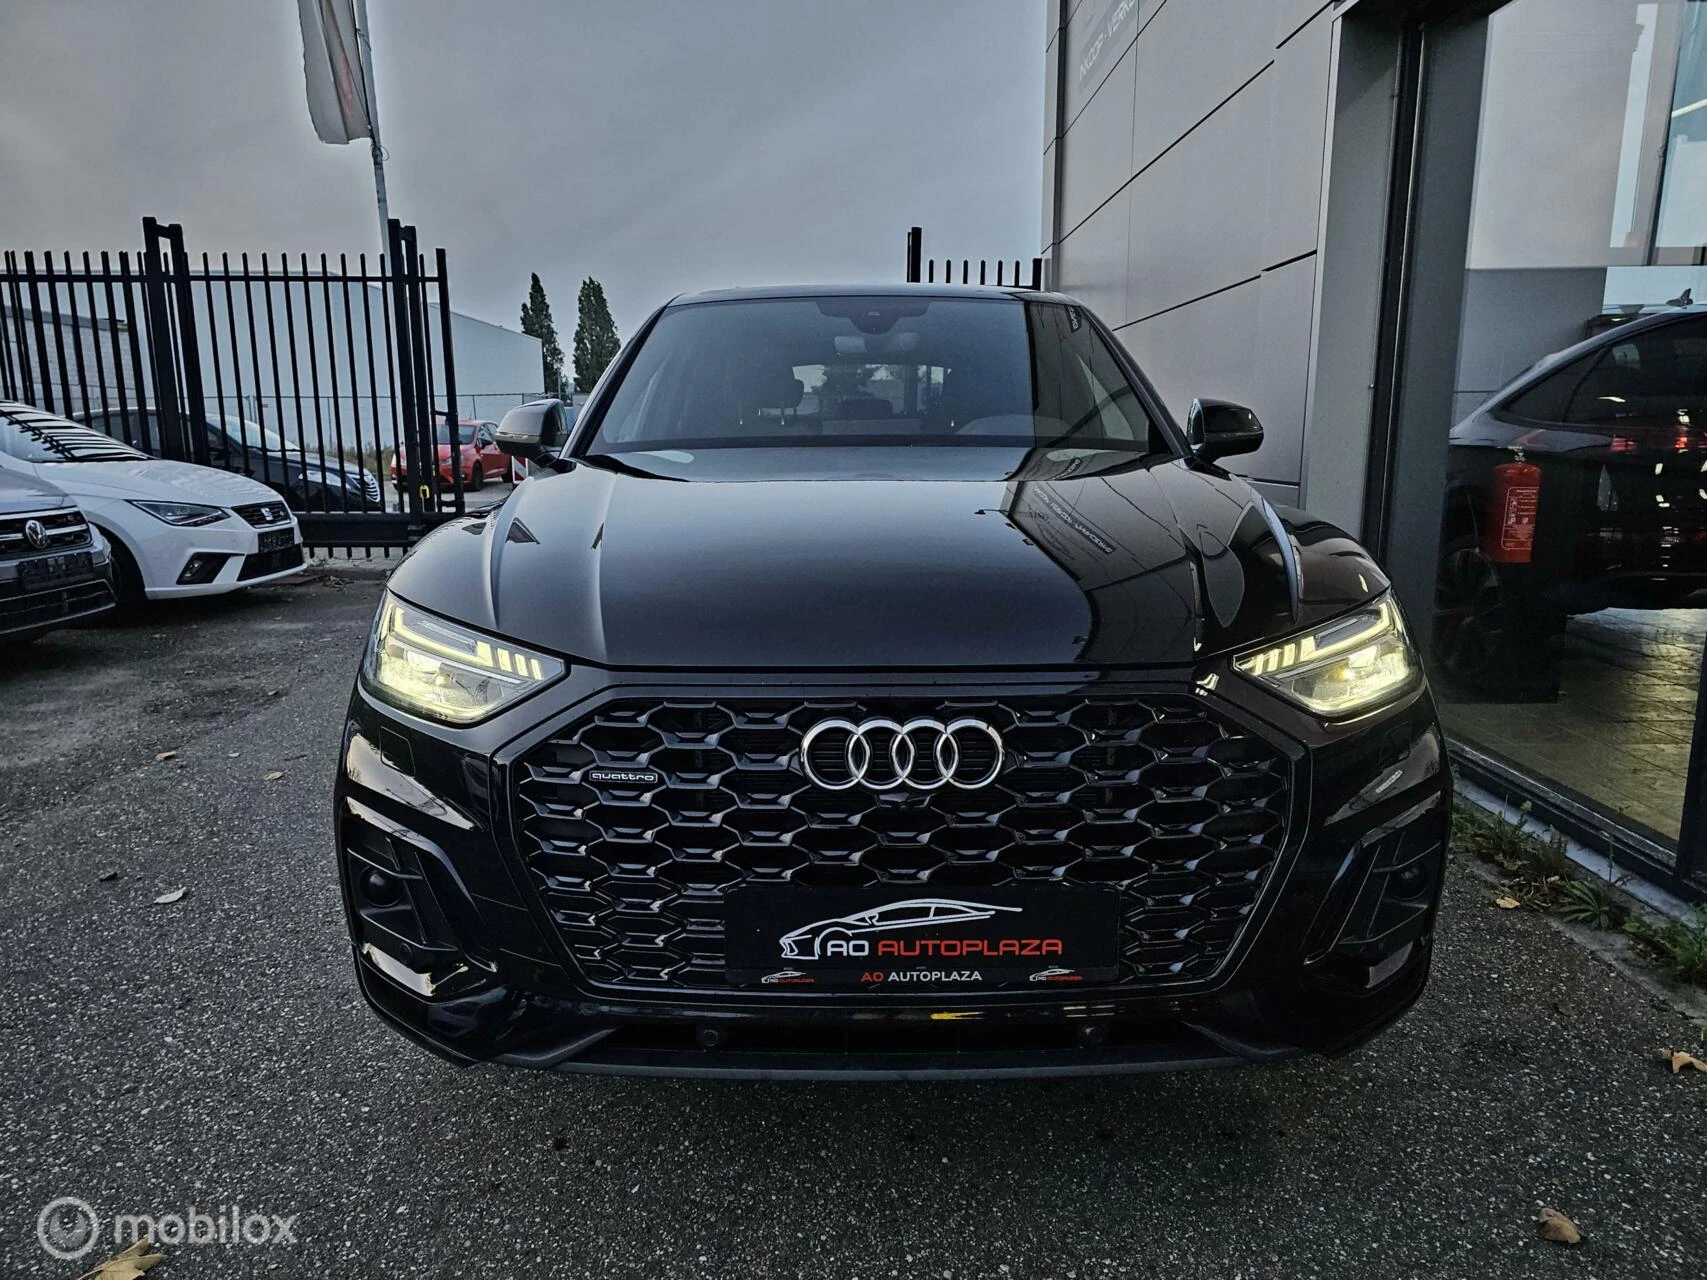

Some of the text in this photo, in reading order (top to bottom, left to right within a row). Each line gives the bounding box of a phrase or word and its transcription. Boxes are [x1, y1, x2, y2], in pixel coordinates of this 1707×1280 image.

[592, 773, 654, 781] quattro
[826, 939, 1062, 957] AO AUTOPLAZA
[861, 971, 983, 982] AO AUTOPLAZA
